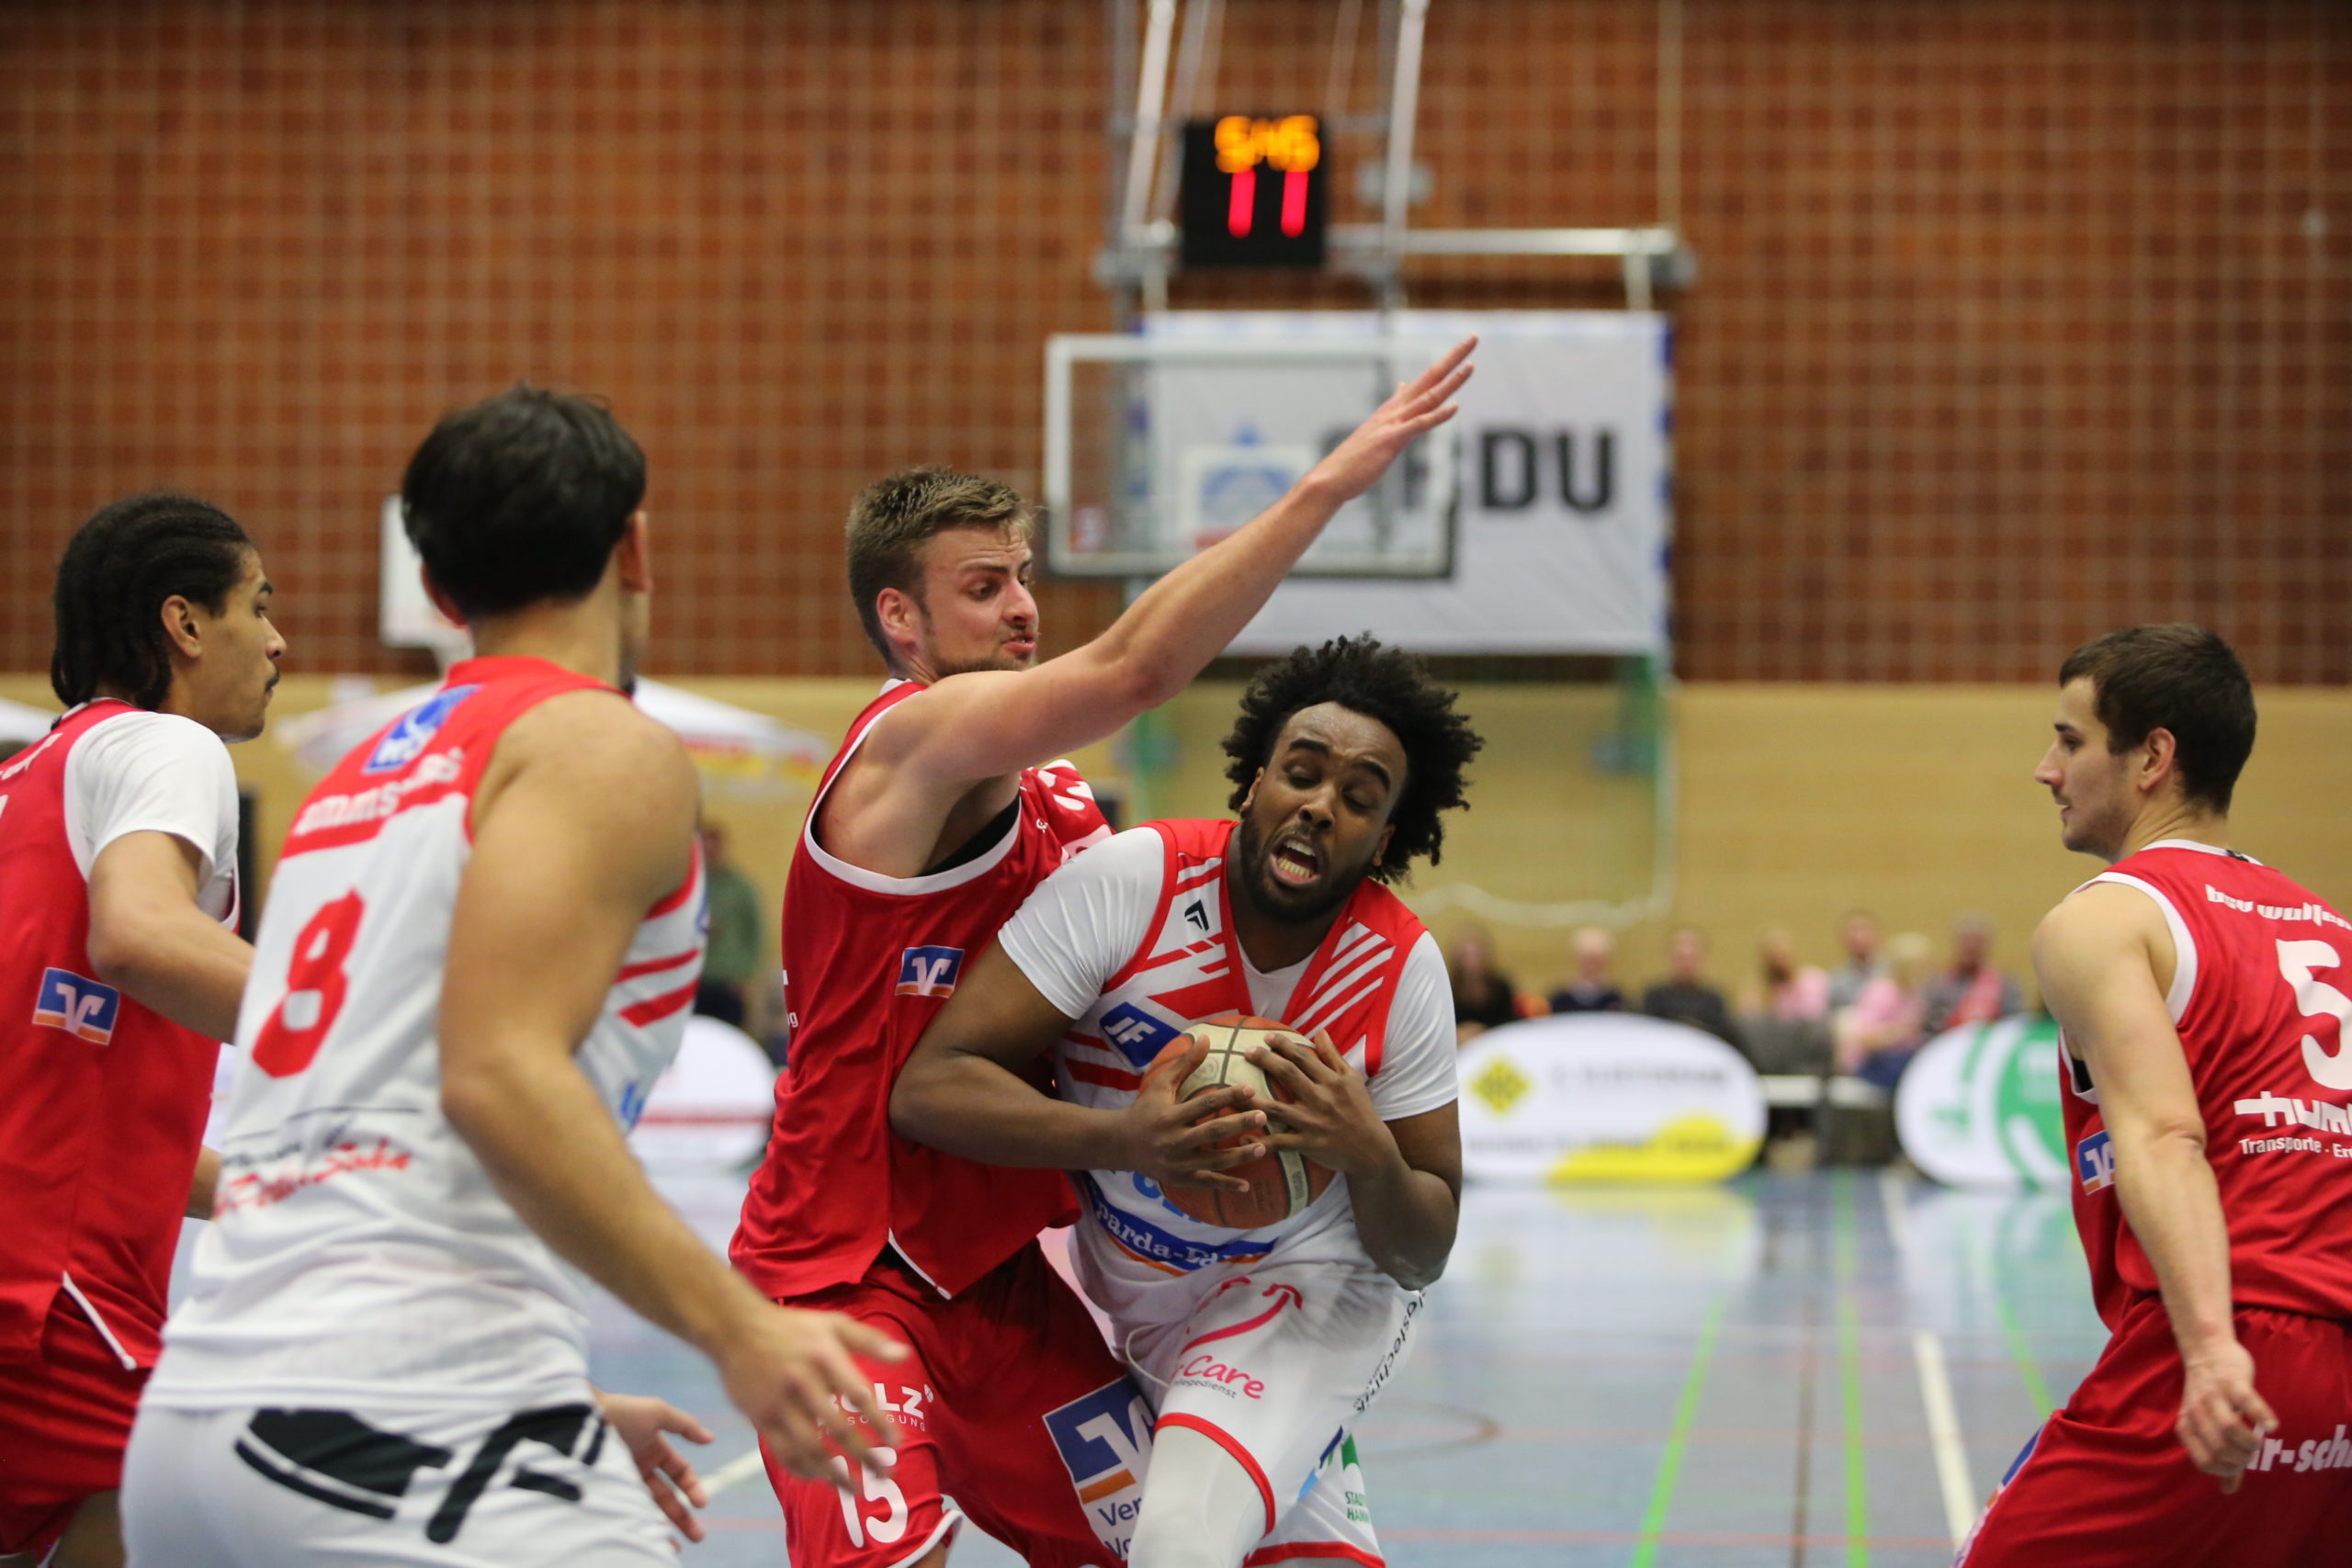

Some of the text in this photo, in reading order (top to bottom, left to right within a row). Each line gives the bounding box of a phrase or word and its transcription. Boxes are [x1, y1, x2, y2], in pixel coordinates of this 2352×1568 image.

[251, 886, 365, 1078] 8
[1102, 1015, 1158, 1046] JF
[2239, 1136, 2322, 1155] Transporte
[1093, 1201, 1257, 1268] parda-Ba
[831, 1446, 909, 1549] 15
